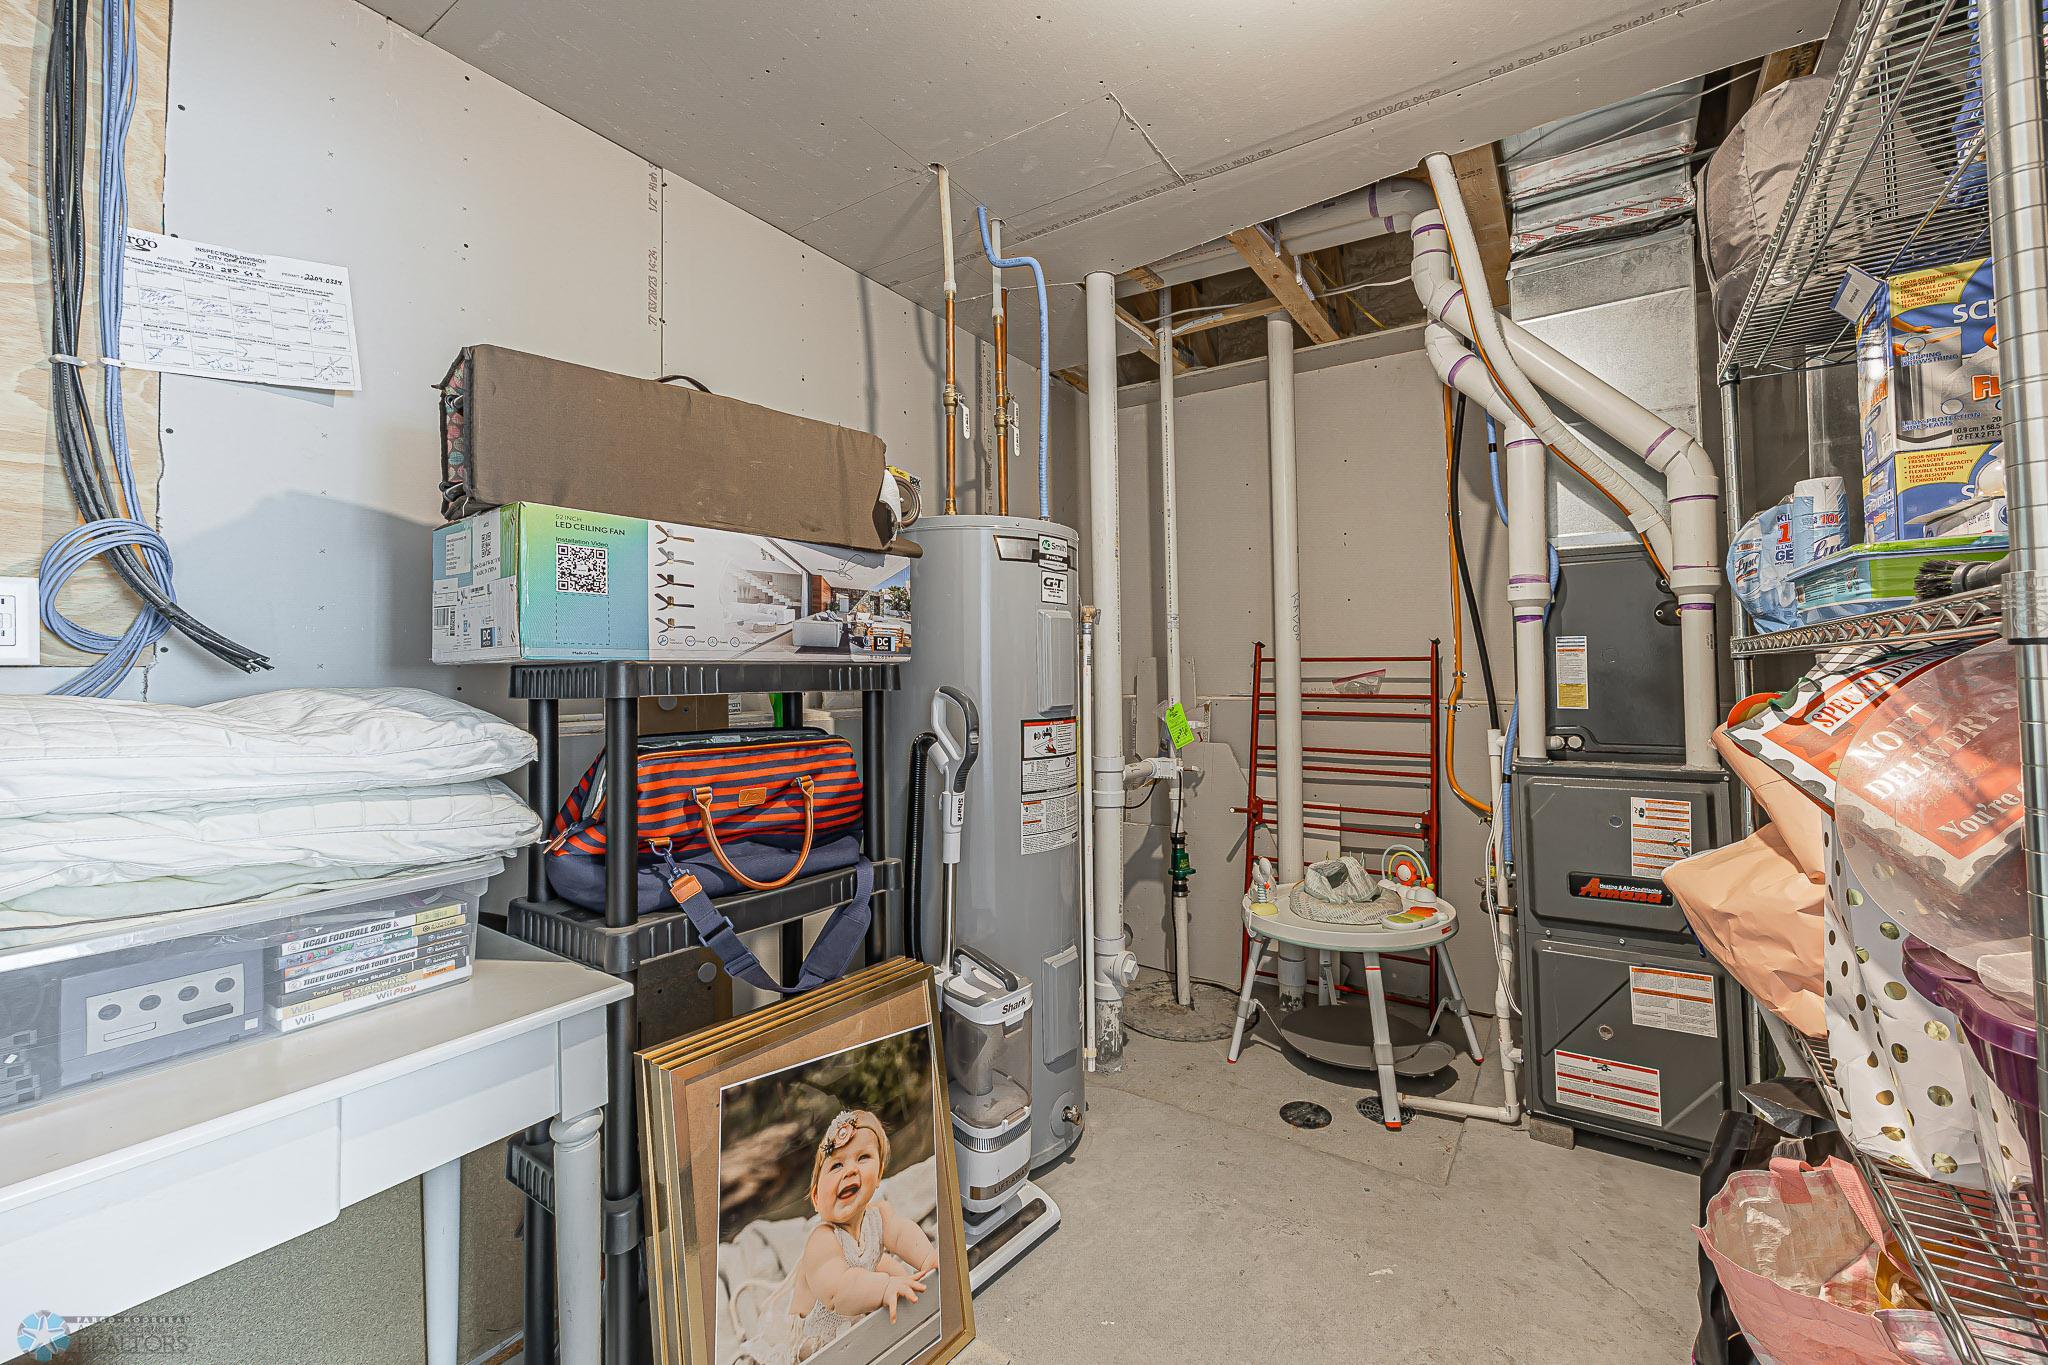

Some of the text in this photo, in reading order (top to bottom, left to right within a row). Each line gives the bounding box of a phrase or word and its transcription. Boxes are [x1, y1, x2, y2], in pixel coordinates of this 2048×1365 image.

[1489, 63, 1514, 77] Gold
[1518, 52, 1544, 68] Bond
[1901, 278, 1966, 295] EXPANDABLE CAPACITY
[1926, 286, 1956, 296] STRENGTH
[1953, 426, 1967, 434] 60.9
[1909, 476, 1947, 484] TECHNOLOGY
[555, 521, 626, 536] LED CEILING FAN
[555, 536, 609, 548] Installation Video
[482, 629, 491, 640] DC
[876, 637, 889, 646] DC
[1811, 673, 1890, 729] SPECIAL
[1864, 708, 2001, 800] DELIVERY
[1937, 792, 2021, 840] You're
[1579, 877, 1663, 904] Amana
[1630, 886, 1663, 894] Conditioning
[302, 921, 392, 949] NCAA FOOTBALL 2005
[304, 975, 326, 986] TIGER
[327, 967, 354, 980] WOODS
[355, 964, 370, 972] PGA
[371, 958, 390, 968] TOUR
[313, 988, 330, 997] Tony
[331, 981, 356, 992] Hawk's
[291, 1003, 310, 1015] Wii
[295, 984, 416, 1025] Wii Wii Play
[1002, 996, 1027, 1015] Shark
